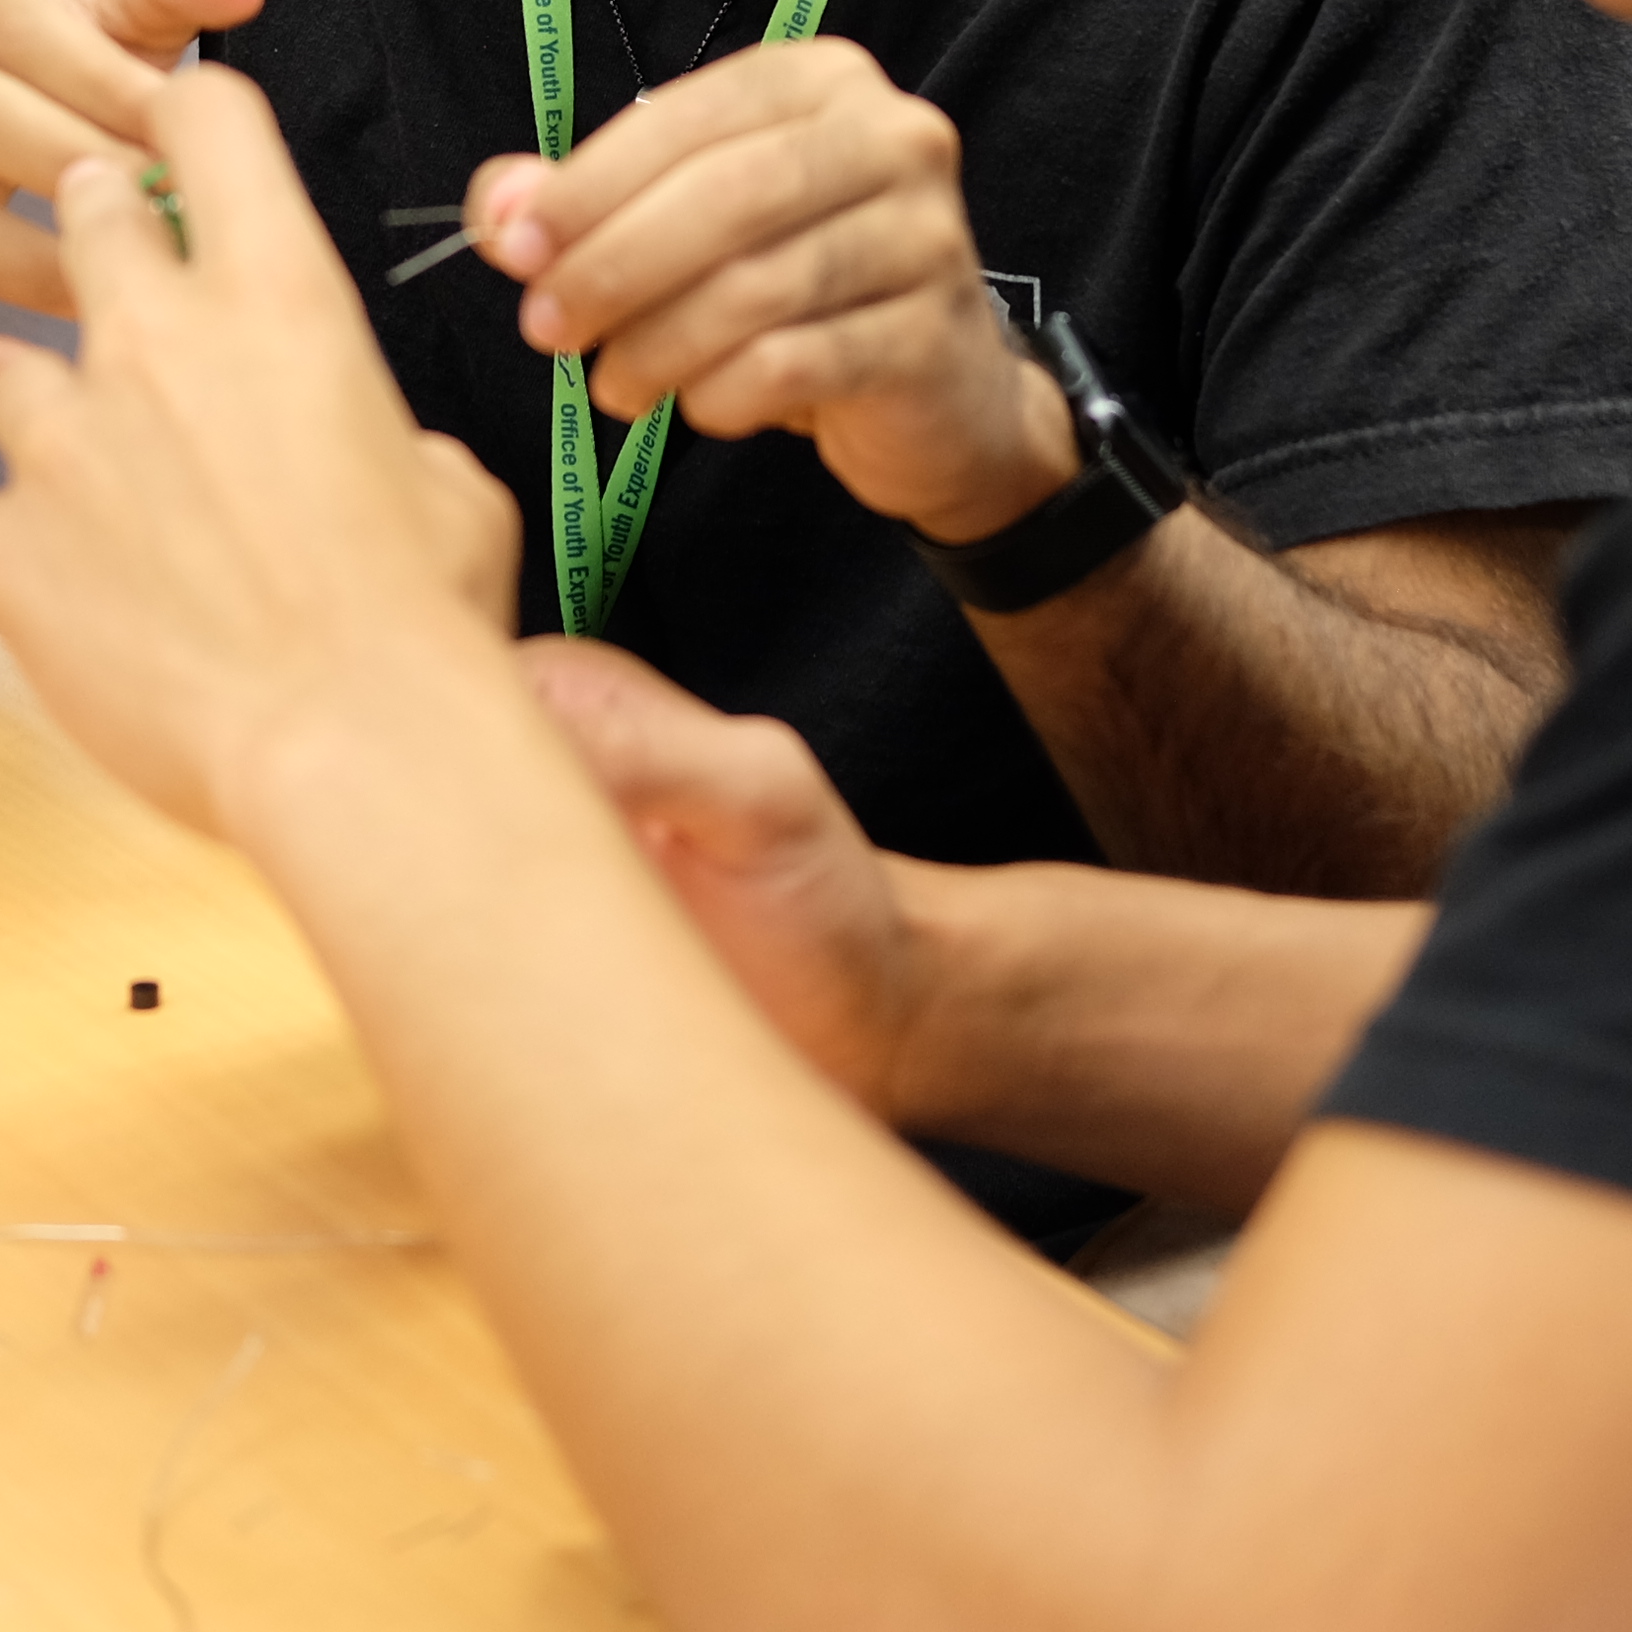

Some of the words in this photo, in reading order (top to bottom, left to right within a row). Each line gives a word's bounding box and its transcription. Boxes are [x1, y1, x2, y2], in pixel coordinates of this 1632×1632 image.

[536, 13, 558, 35] of
[539, 39, 561, 100] Youth
[545, 109, 562, 161] Expe
[561, 403, 579, 466] Office
[562, 472, 584, 493] of
[564, 498, 588, 558] Youth
[603, 513, 634, 563] Youth
